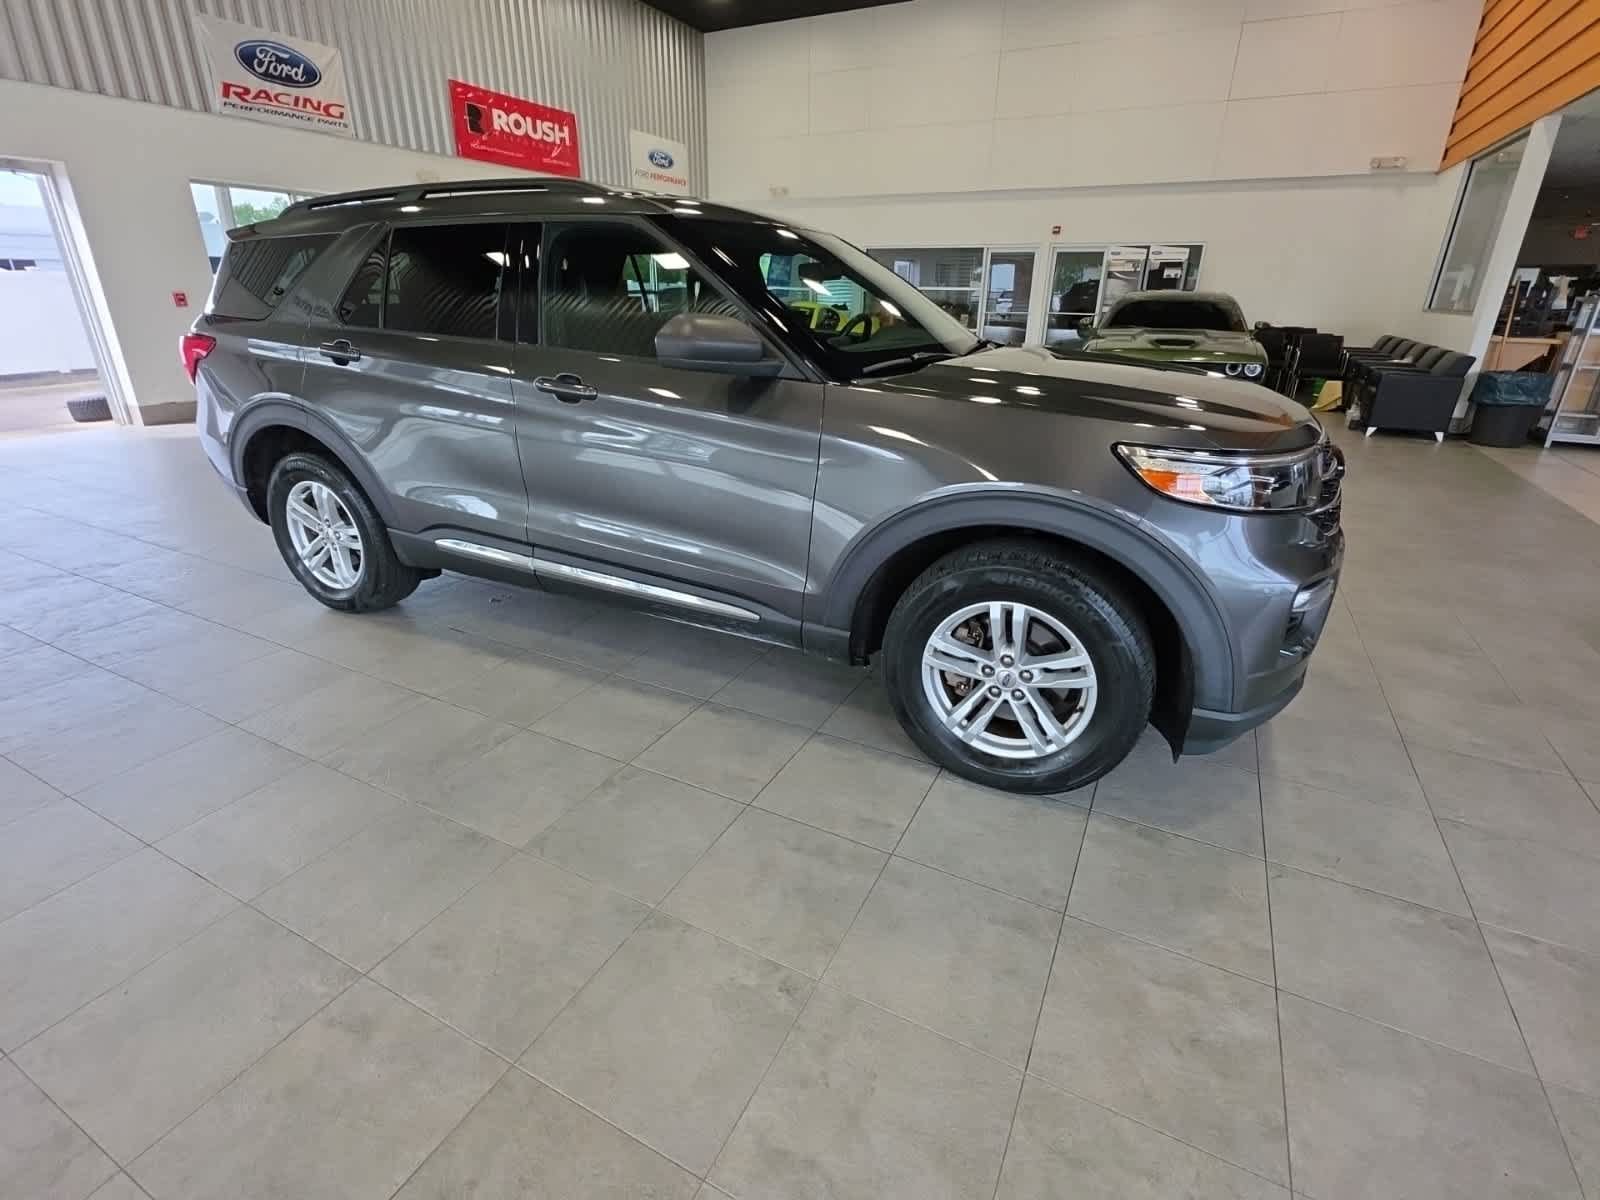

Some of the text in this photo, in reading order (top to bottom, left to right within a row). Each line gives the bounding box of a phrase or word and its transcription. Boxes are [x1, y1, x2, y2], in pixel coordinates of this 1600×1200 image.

[253, 46, 306, 82] Ford
[221, 82, 345, 119] RACING
[223, 101, 349, 129] PERFORMANCE PARTS
[492, 108, 570, 146] ROUSH
